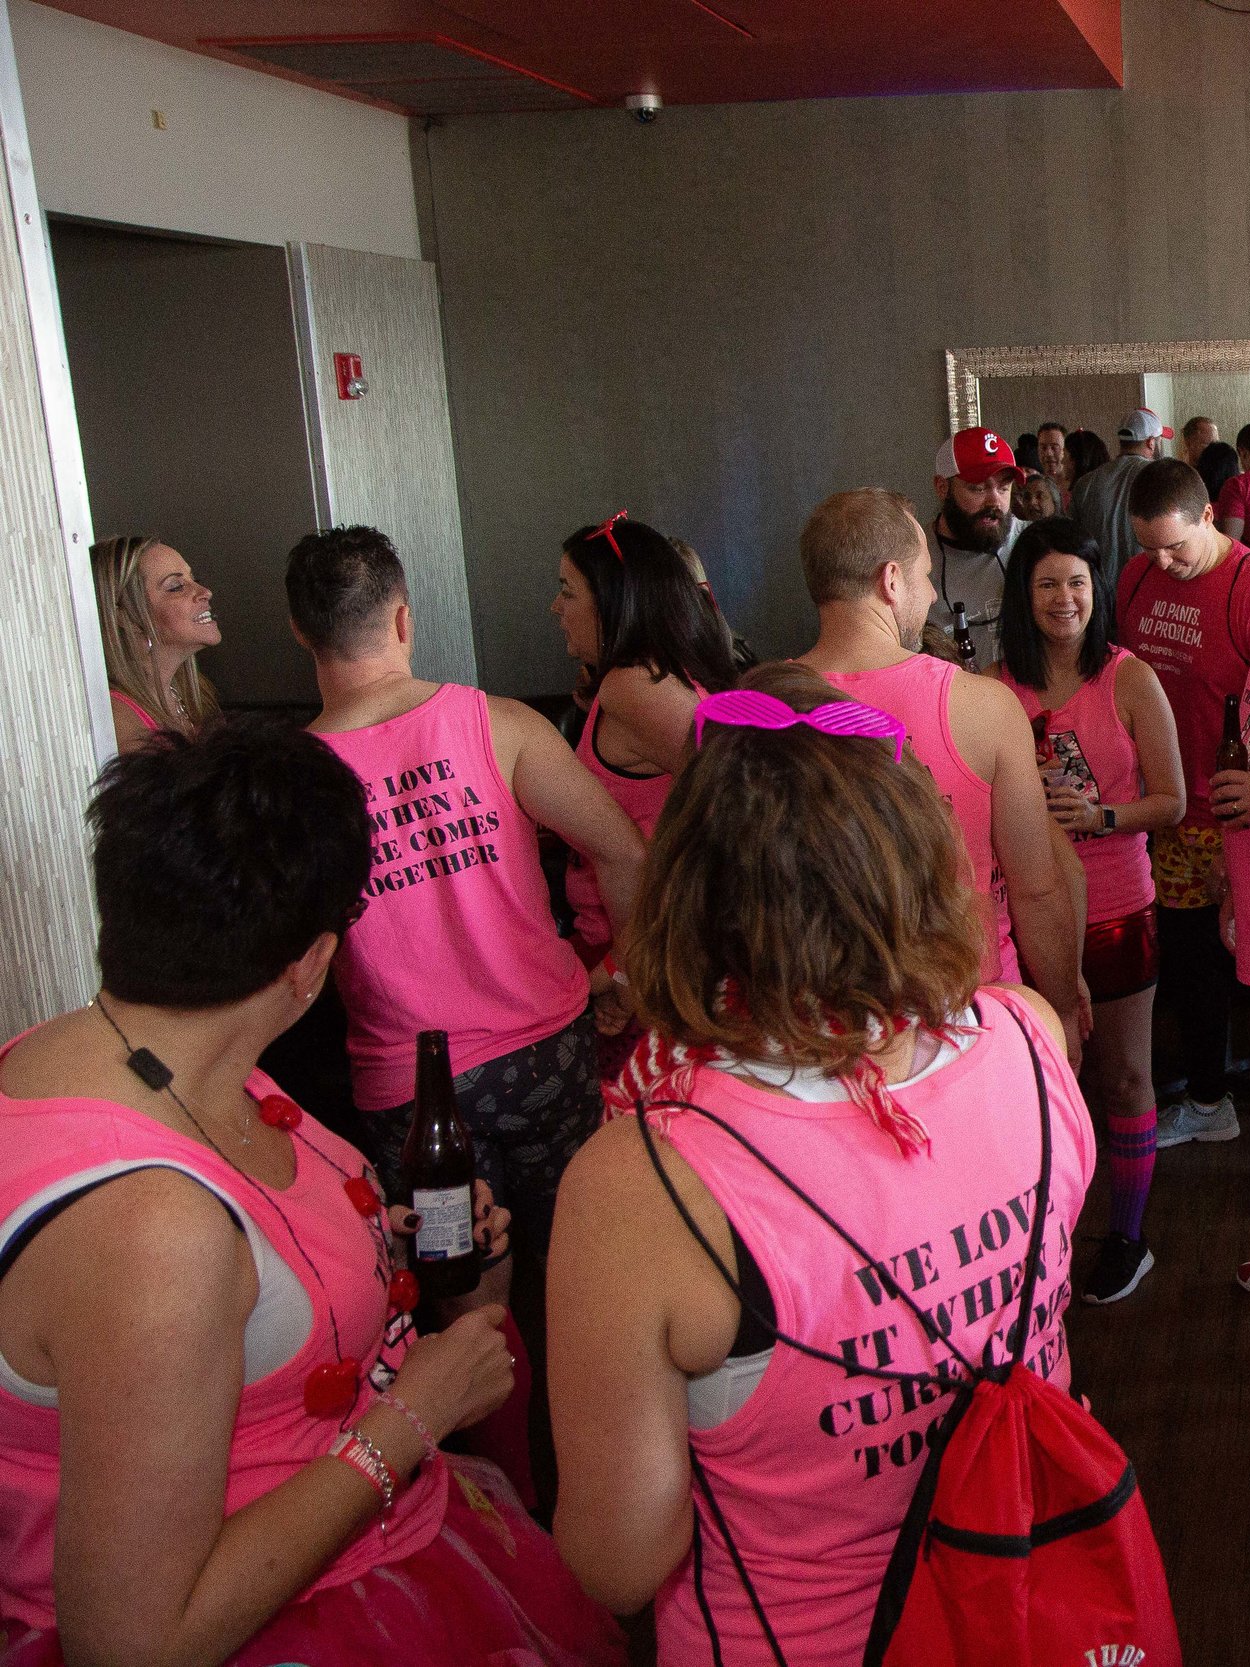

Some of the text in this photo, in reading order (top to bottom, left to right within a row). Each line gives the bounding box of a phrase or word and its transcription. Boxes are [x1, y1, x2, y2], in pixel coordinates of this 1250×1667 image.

[1138, 616, 1203, 649] NO PROBLEM.
[1151, 600, 1201, 626] NO PANTS.
[382, 758, 456, 798] LOVE
[369, 786, 482, 834] WHEN A
[370, 810, 500, 867] RE COMES
[362, 843, 500, 898] OGETHER
[837, 1323, 898, 1379] IT
[1057, 1220, 1068, 1267] A
[854, 1241, 939, 1306] WE
[818, 1355, 965, 1438] CURE
